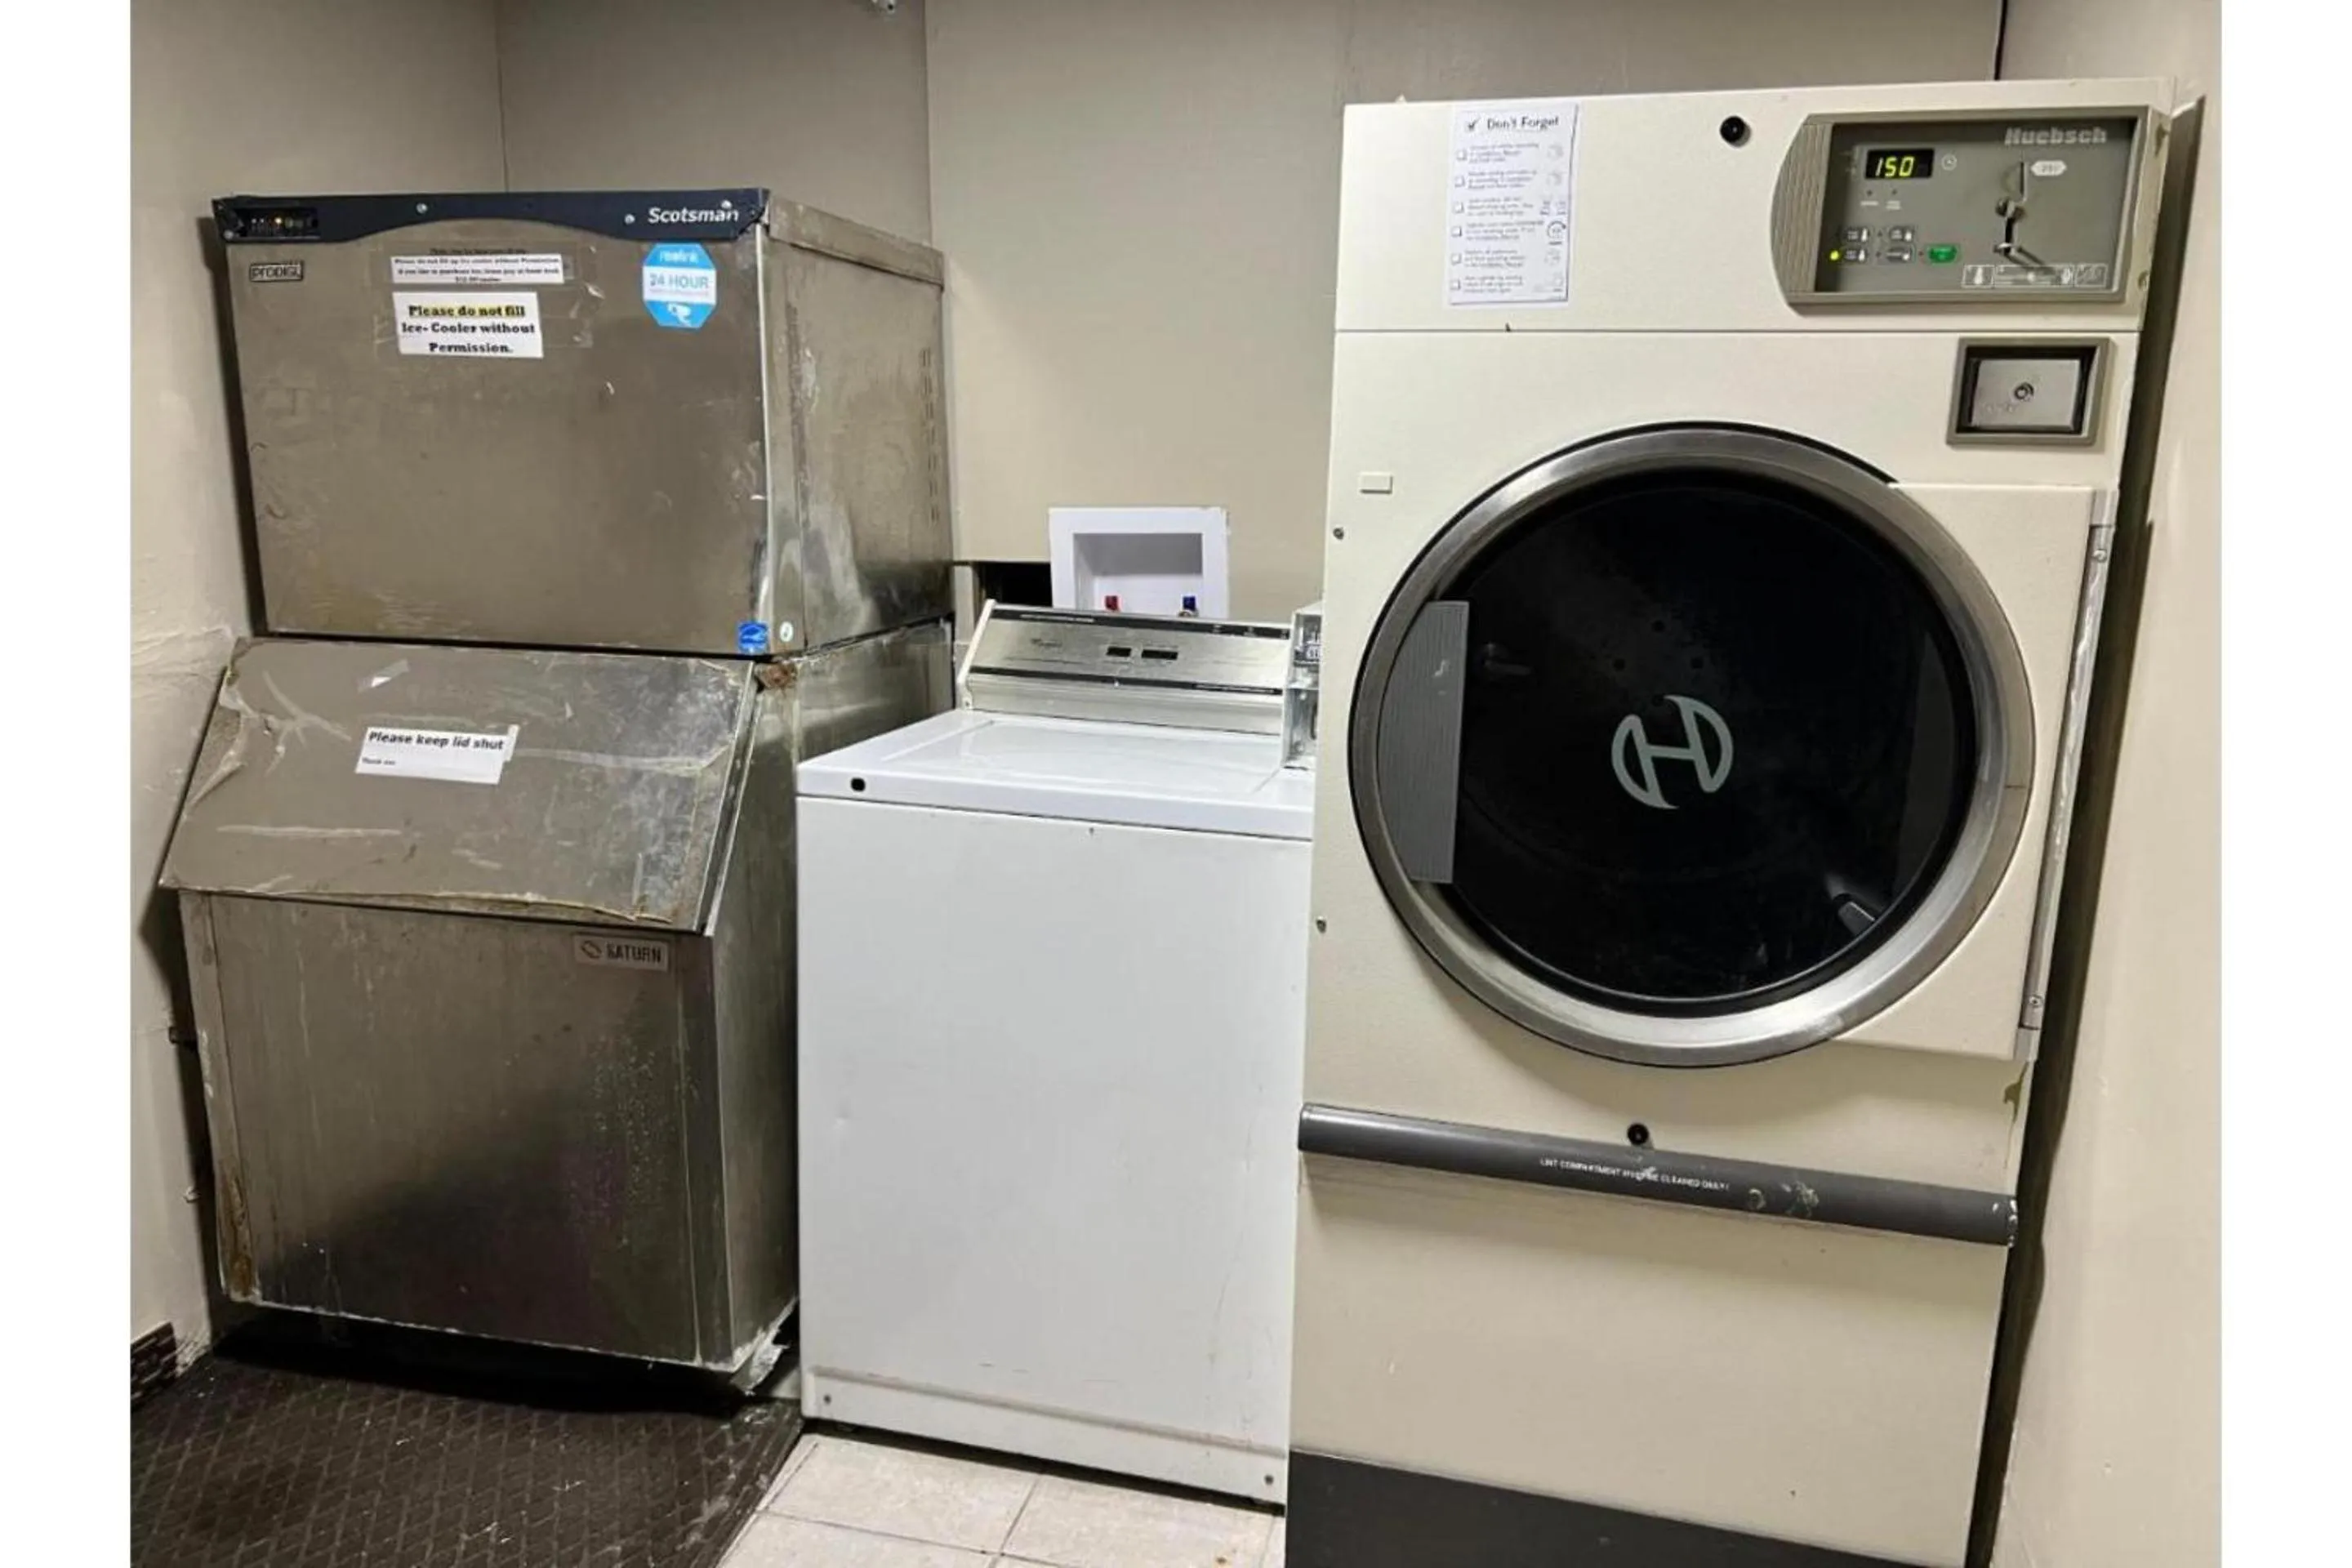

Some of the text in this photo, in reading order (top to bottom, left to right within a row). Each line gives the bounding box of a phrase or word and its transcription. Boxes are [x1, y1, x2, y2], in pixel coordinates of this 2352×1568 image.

[1487, 115, 1559, 131] Don't Forget
[2004, 126, 2107, 145] Huebsch
[1875, 155, 1915, 177] 150
[648, 207, 740, 224] Scotsman
[649, 272, 710, 289] 24 HOUR
[408, 305, 526, 317] Please do not fill
[431, 322, 477, 333] Cooler
[480, 322, 536, 334] without
[429, 341, 514, 354] Permission.
[368, 731, 505, 750] Please keep lid shut
[606, 942, 662, 964] SATURN
